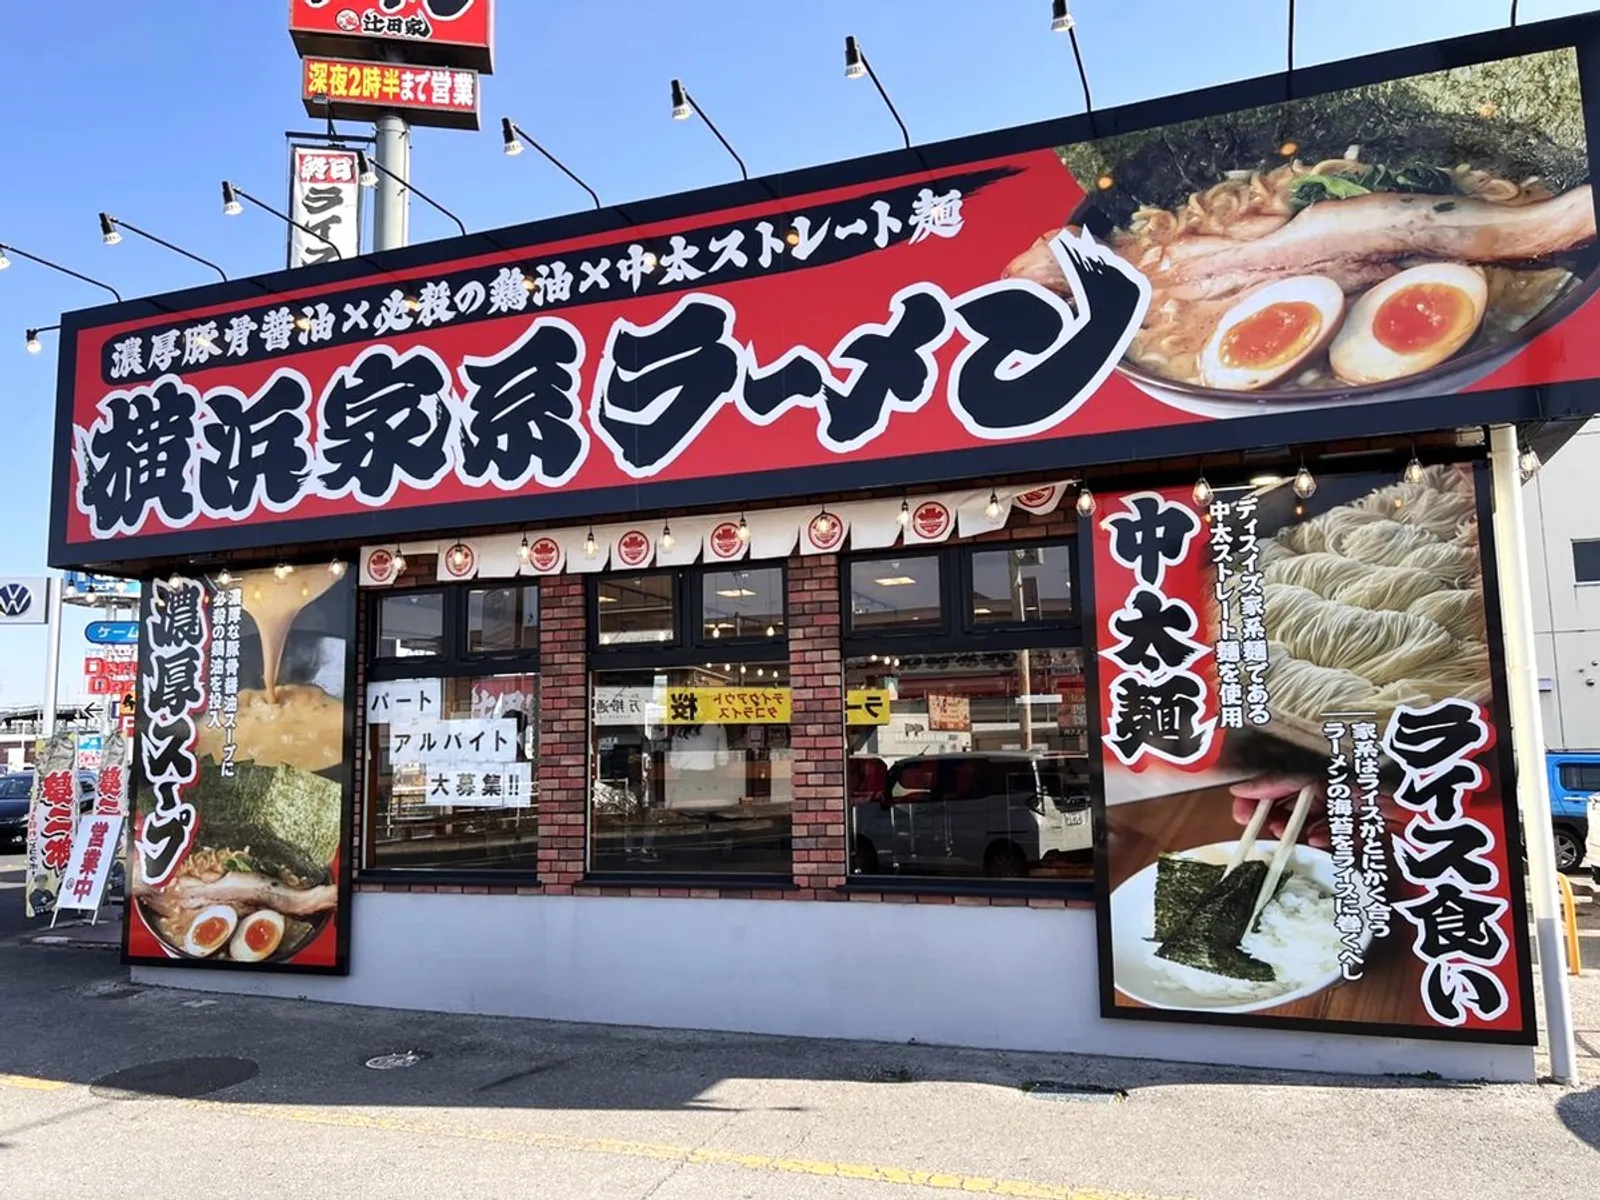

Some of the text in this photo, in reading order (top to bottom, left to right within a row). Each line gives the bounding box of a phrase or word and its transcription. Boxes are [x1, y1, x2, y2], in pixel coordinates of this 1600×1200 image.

[308, 62, 475, 106] 深夜2時半まで営業
[363, 10, 431, 38] 辻田家
[300, 154, 354, 181] 終日
[76, 226, 1150, 538] 横浜家系ラーメン
[221, 588, 242, 777] 濃厚な豚骨醤油スープに
[371, 690, 432, 712] パート
[1100, 492, 1213, 763] 中太麺
[1209, 500, 1243, 729] 中太ストレート麺を使用
[1236, 497, 1270, 726] ディスイズ家系麺である
[137, 578, 206, 884] 濃厚スープ
[394, 729, 508, 754] アルバイト
[1350, 722, 1393, 938] 家系はライスがとにかく合う
[73, 821, 110, 903] 営業中
[1386, 699, 1508, 1025] ライス食い
